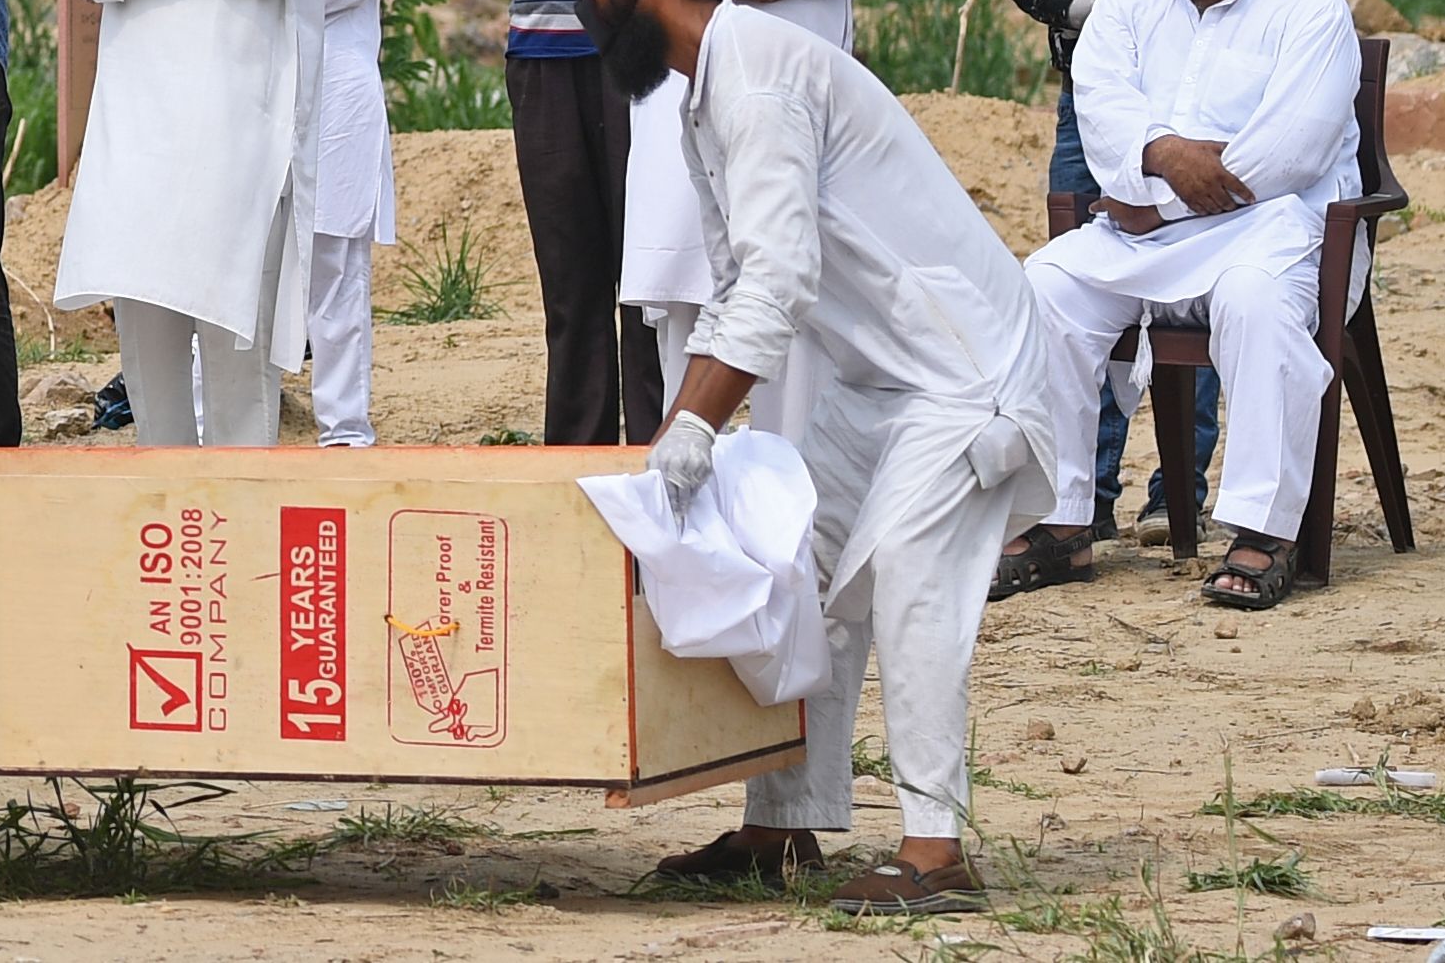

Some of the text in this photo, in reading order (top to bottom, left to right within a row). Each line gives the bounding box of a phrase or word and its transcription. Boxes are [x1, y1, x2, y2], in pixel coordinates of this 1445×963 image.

[139, 522, 173, 636] AN ISO
[180, 509, 203, 645] 9001:2008
[210, 511, 227, 732] COMPANY
[317, 519, 338, 680] GUARANTEED
[436, 535, 453, 587] Proof
[458, 579, 472, 594] &
[475, 519, 495, 654] Termite Resistant
[287, 544, 343, 735] 15 YEARS
[408, 650, 428, 698] 100%
[411, 633, 440, 699] IMPORTED
